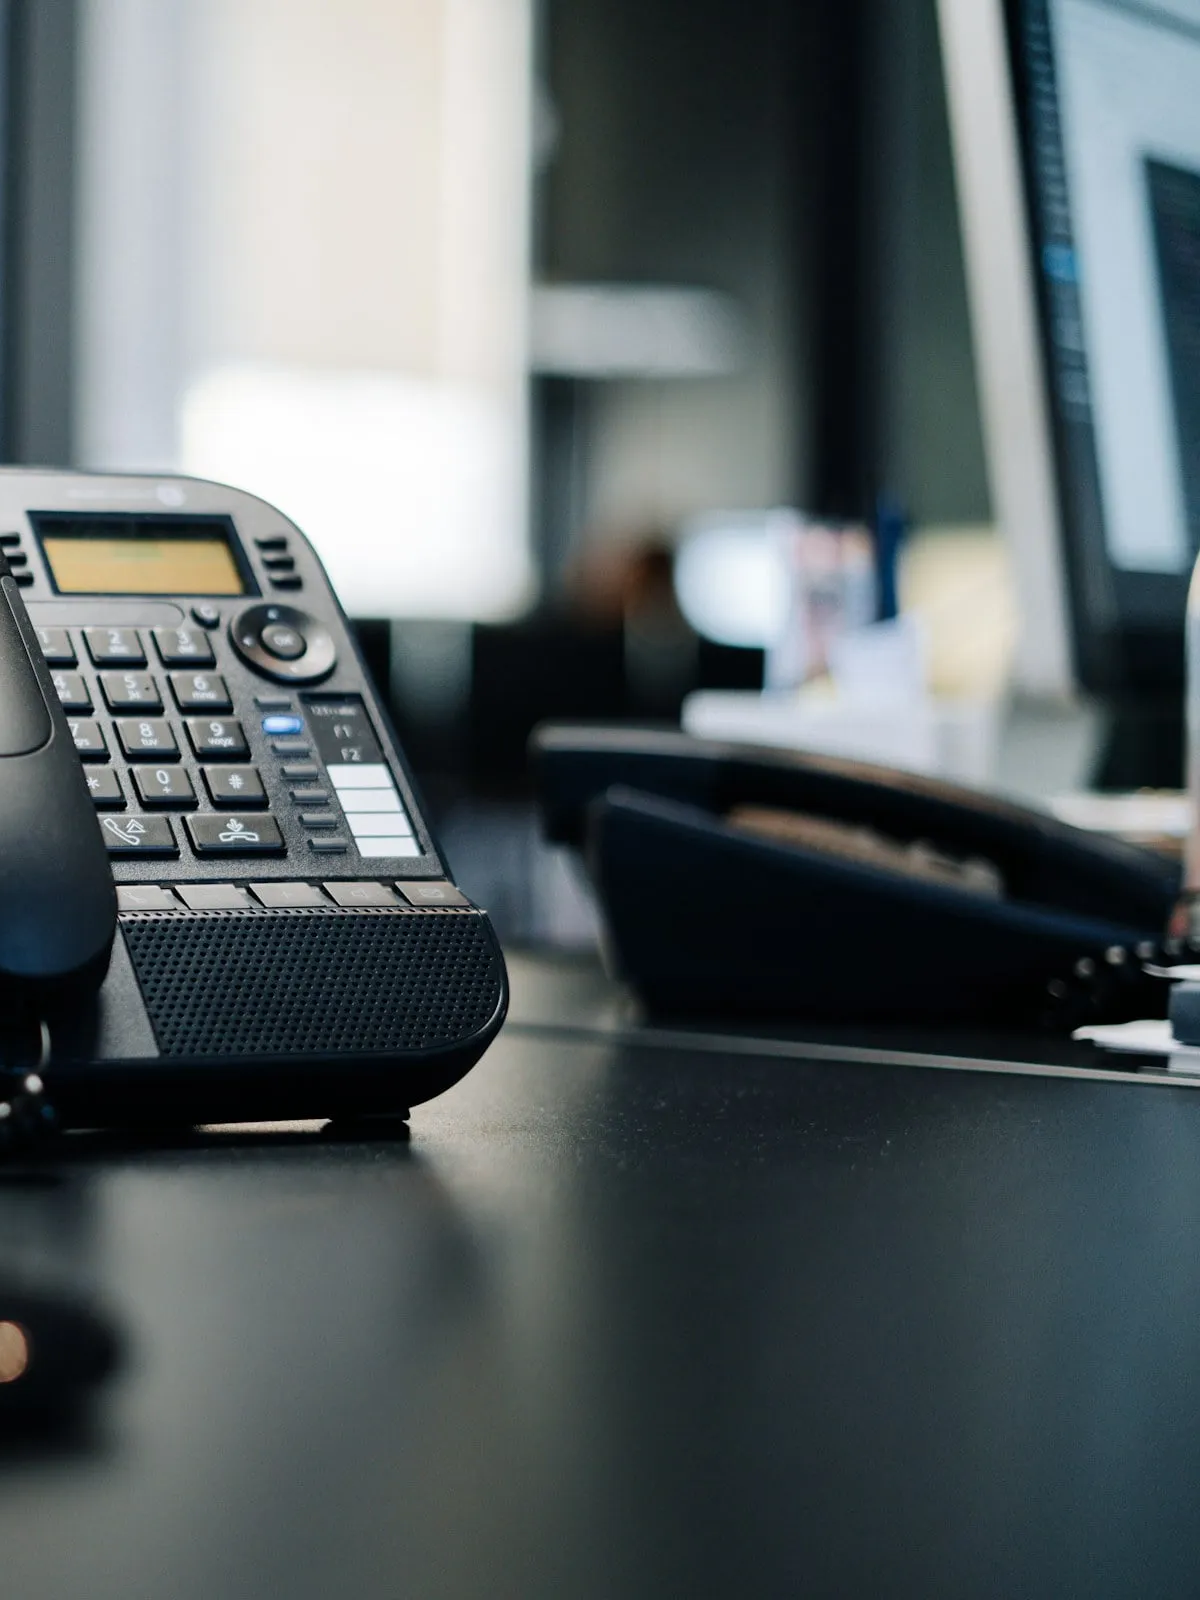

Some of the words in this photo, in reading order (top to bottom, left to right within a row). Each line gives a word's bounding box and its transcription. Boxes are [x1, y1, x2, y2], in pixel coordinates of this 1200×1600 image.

[38, 630, 49, 645] 1
[108, 630, 122, 645] 2
[176, 630, 190, 645] 3
[54, 675, 67, 689] 4
[124, 675, 138, 689] 5
[193, 675, 208, 690] 6
[69, 723, 79, 737] 7
[139, 722, 153, 738] 8
[209, 722, 224, 738] 9
[333, 724, 351, 738] F1
[341, 747, 361, 761] F2
[156, 769, 170, 785] 0
[228, 773, 244, 790] #
